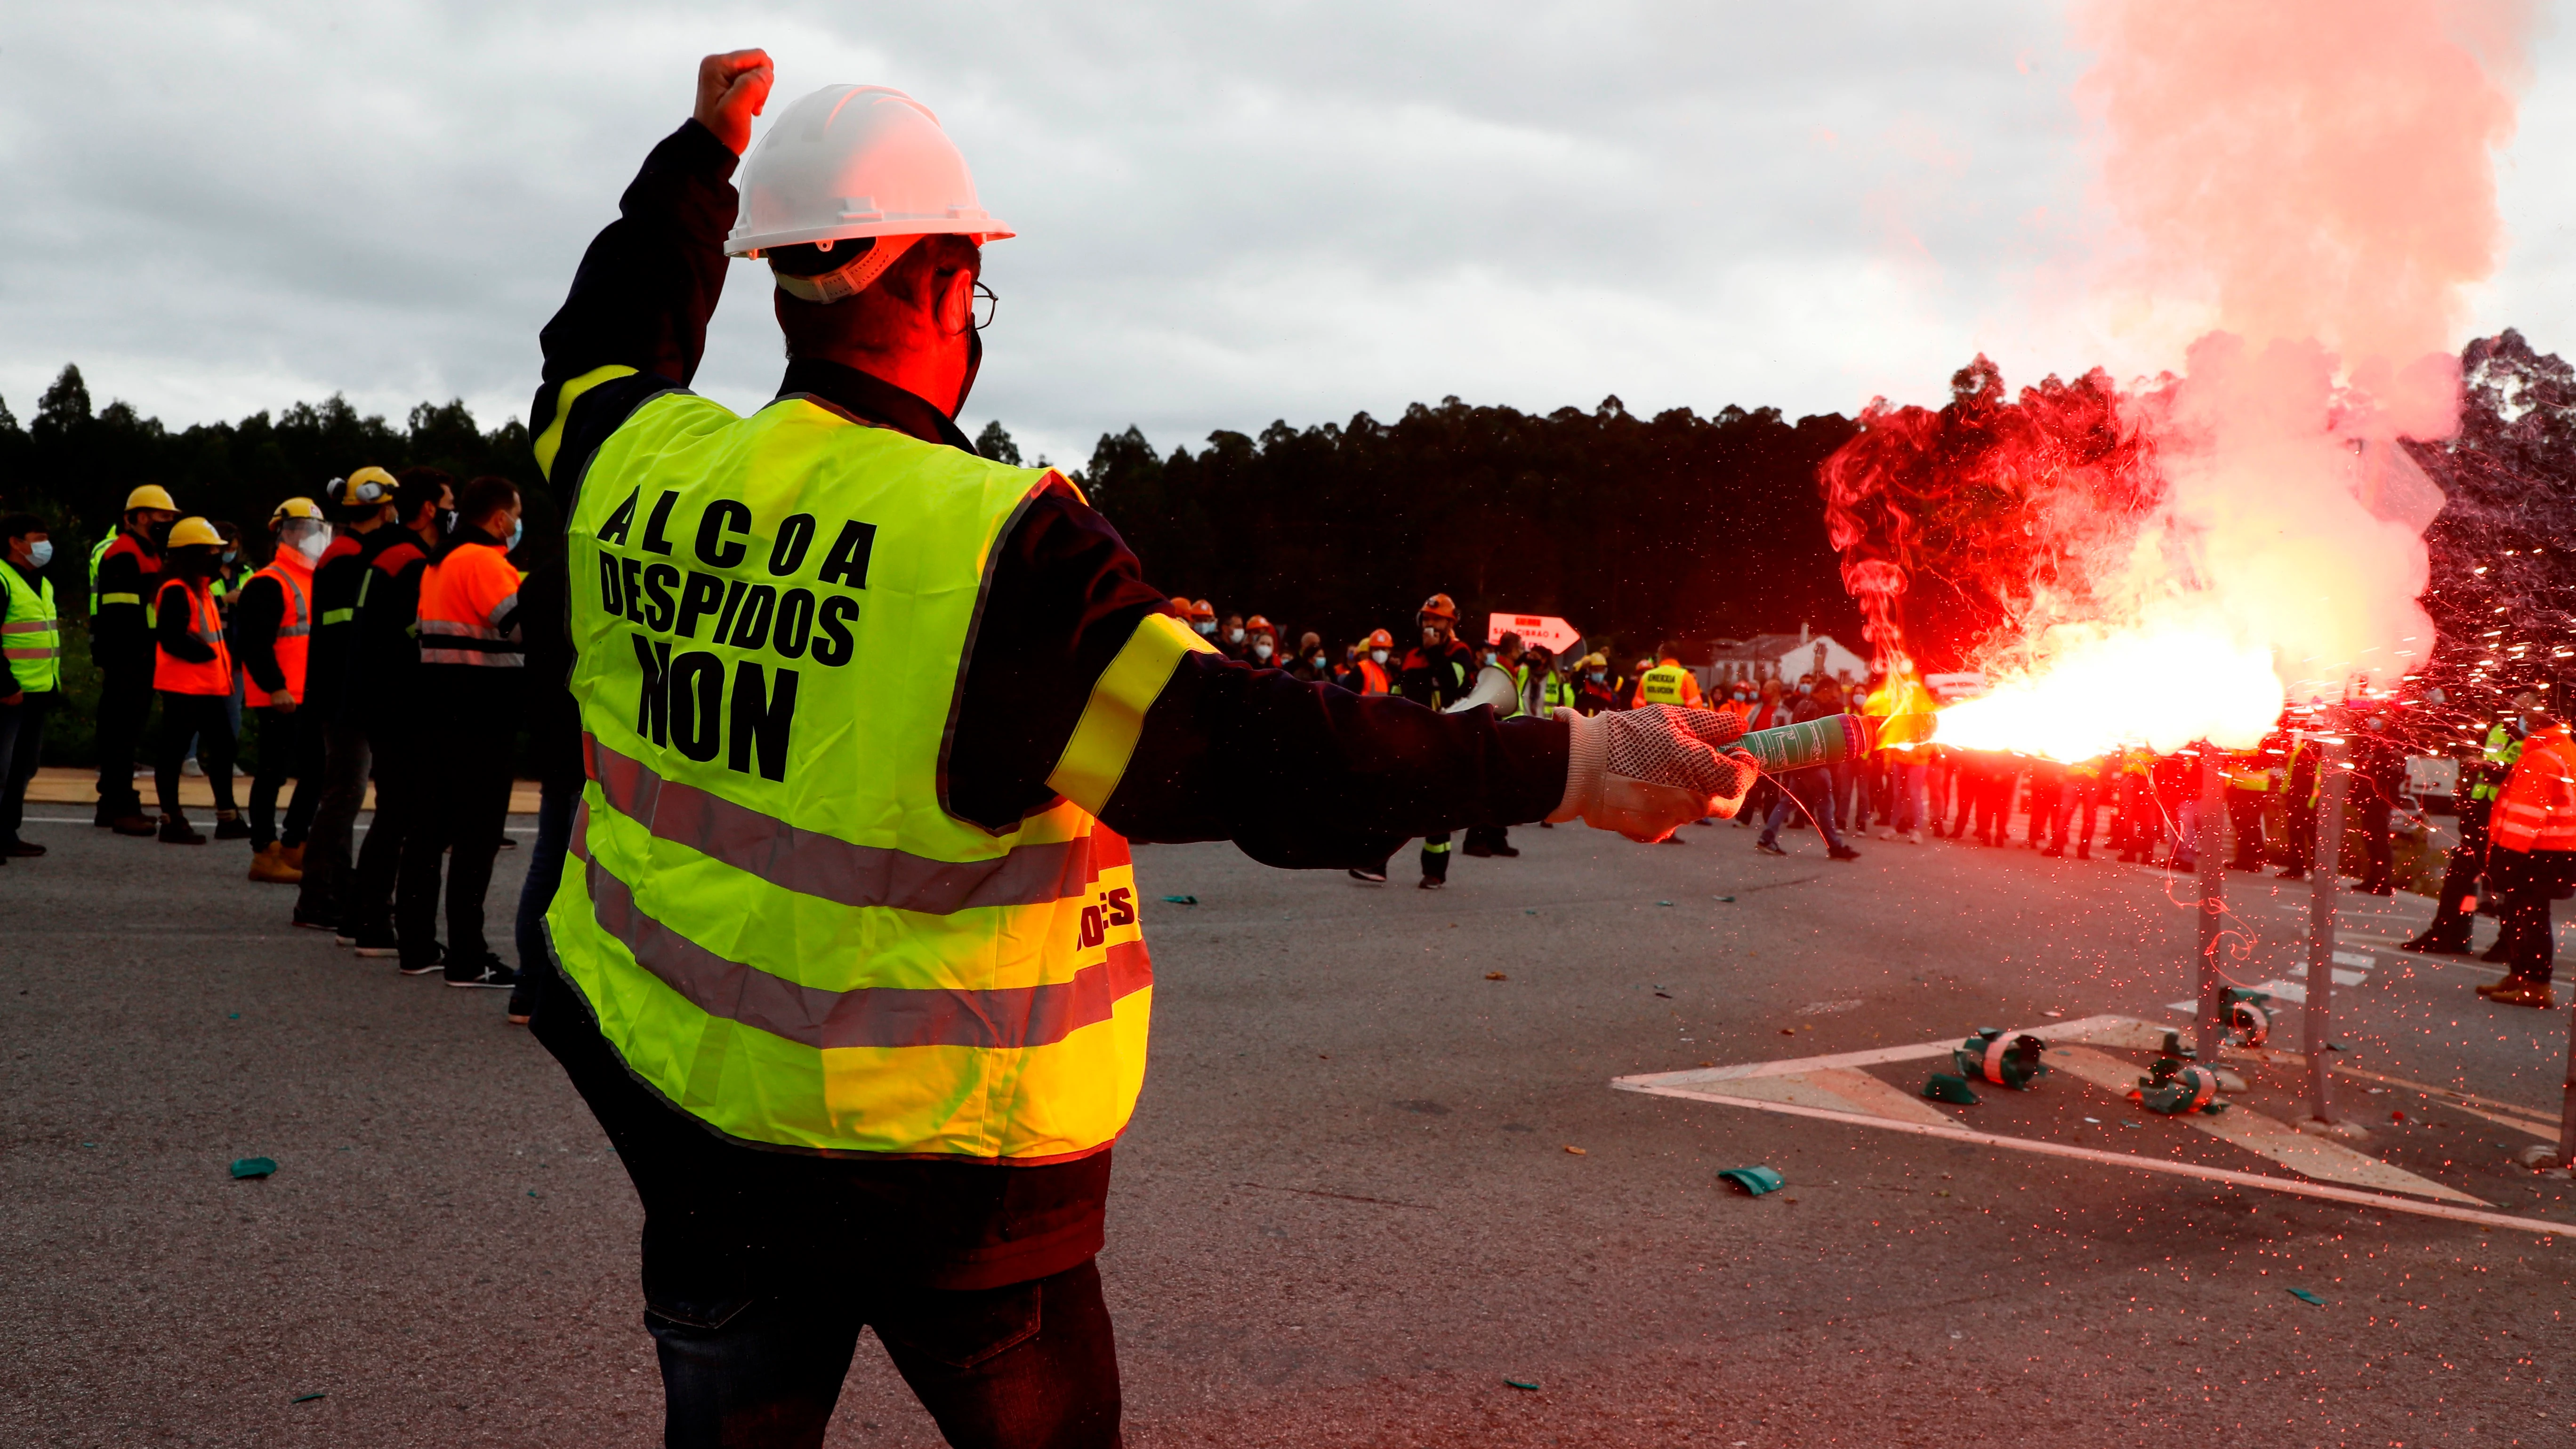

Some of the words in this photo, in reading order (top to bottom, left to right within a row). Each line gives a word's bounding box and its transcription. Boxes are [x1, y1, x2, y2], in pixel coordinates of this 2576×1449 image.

[596, 484, 877, 590] ALCOA
[599, 549, 860, 667] DESPIDOS
[631, 632, 799, 783] NON
